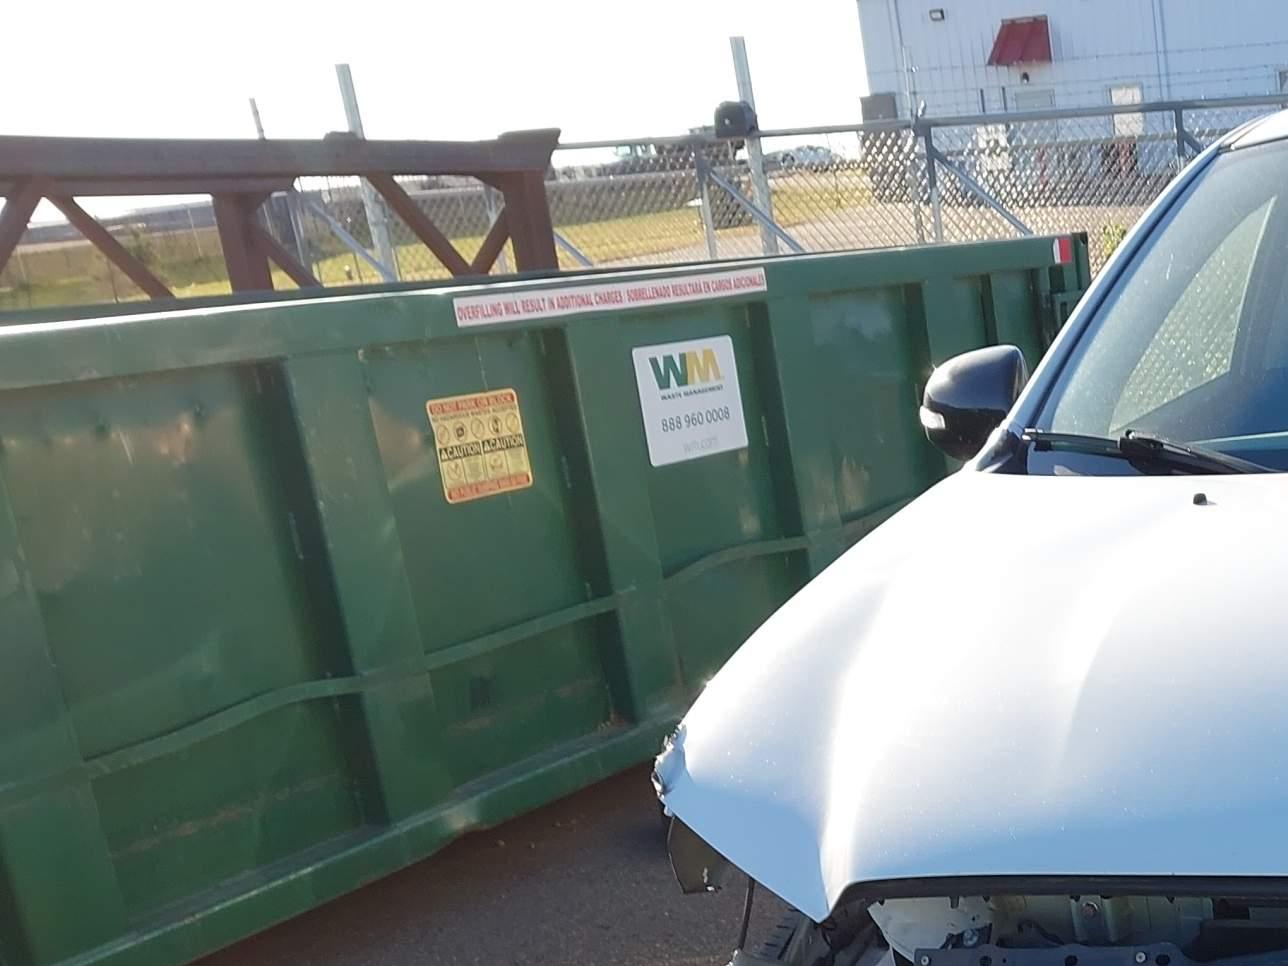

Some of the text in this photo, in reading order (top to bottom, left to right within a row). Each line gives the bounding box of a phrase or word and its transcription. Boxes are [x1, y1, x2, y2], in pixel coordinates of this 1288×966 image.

[457, 301, 502, 320] OVERFILLING
[503, 300, 520, 315] WILL
[521, 297, 545, 314] RESULT
[548, 296, 556, 310] IN
[556, 292, 593, 309] ADDITIONAL
[594, 289, 622, 305] CHARGES
[626, 284, 671, 302] SOBRELLENADO
[702, 279, 711, 294] EN
[711, 276, 732, 293] CARGOS
[648, 348, 722, 391] WM
[661, 384, 724, 401] WASTE MANAGEMENT
[661, 405, 730, 433] 888 960 0008
[447, 442, 482, 459] CAUTION
[490, 434, 524, 451] CAUTION
